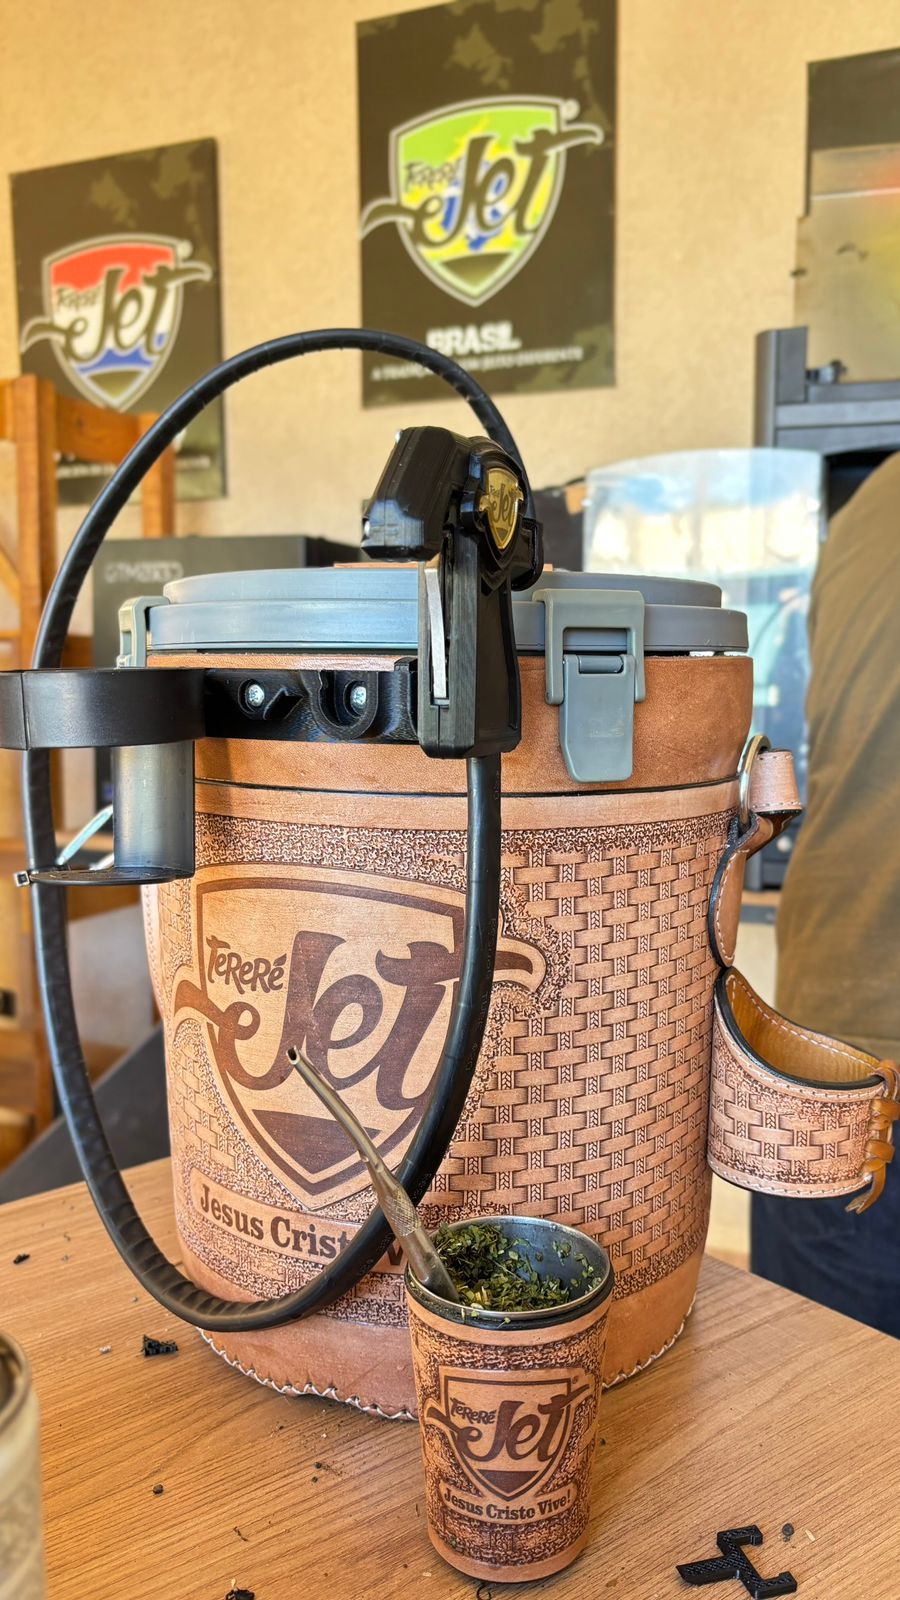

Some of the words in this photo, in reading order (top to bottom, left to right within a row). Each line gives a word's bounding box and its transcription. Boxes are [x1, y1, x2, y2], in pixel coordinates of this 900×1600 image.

[201, 1183, 264, 1241] Jesus
[271, 1216, 351, 1258] Crist
[444, 1488, 483, 1517] Jesus
[485, 1503, 535, 1520] Cristo
[538, 1489, 571, 1515] Vive!
